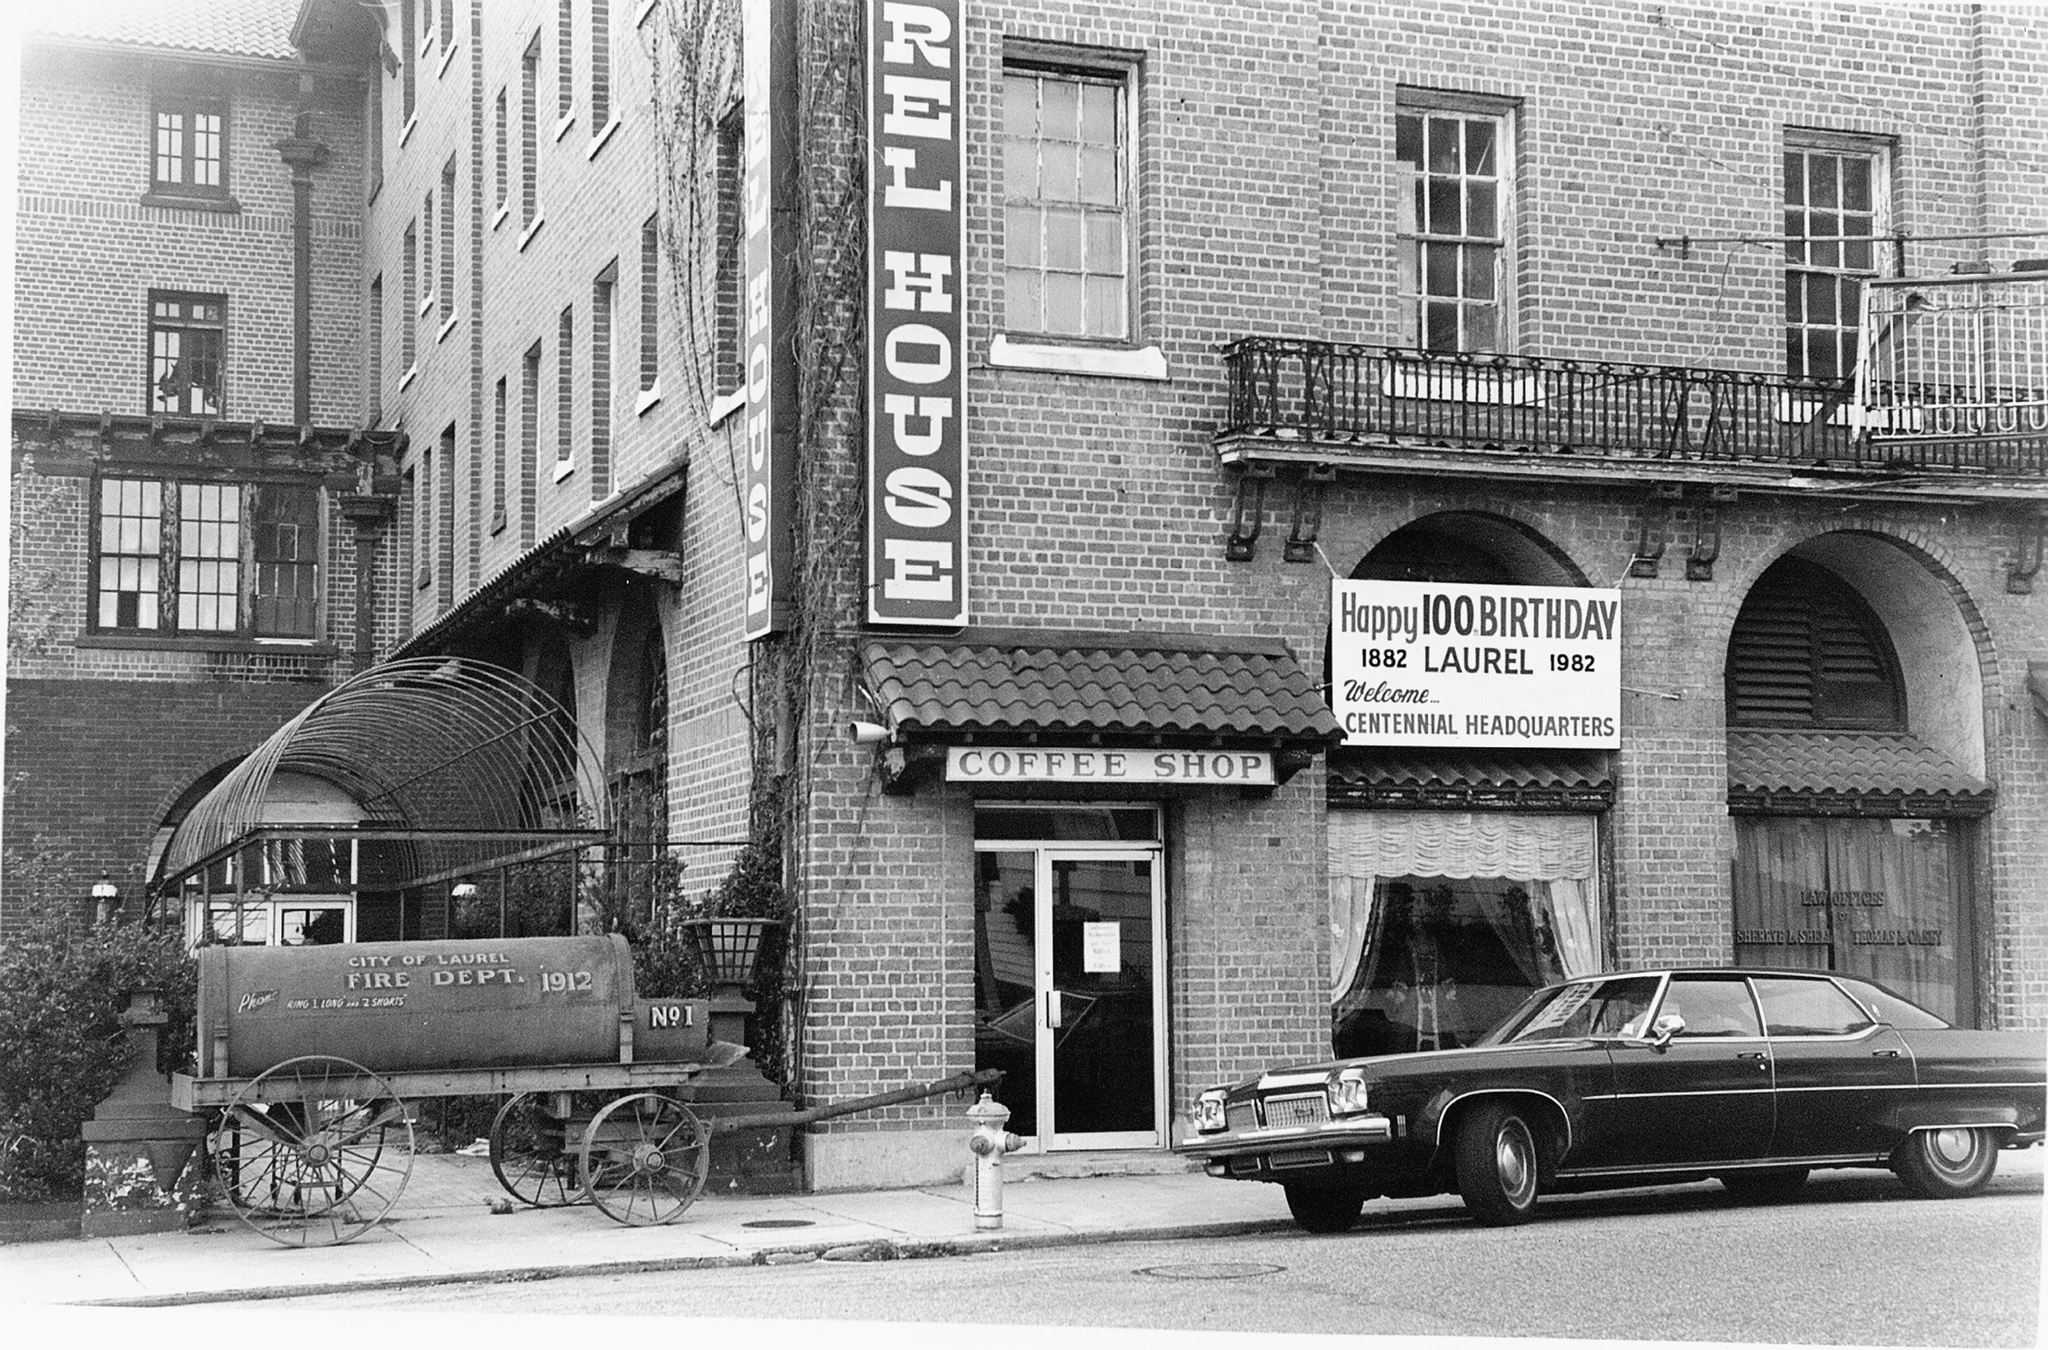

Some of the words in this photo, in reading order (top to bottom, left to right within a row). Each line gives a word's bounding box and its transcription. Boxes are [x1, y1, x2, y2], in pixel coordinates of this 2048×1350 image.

[883, 1, 952, 211] REL
[884, 251, 953, 602] HOUSE
[747, 266, 769, 616] HOUSE
[1341, 592, 1418, 644] Happy
[1423, 594, 1475, 636] 100
[1480, 595, 1618, 641] BIRTHDAY
[1361, 648, 1407, 668] 1882
[1424, 646, 1534, 675] LAUREL
[1550, 654, 1596, 672] 1982
[1343, 679, 1440, 704] Welcome...
[1345, 712, 1458, 735] CENTENNIAL
[1465, 715, 1615, 738] HEADQUARTERS
[958, 751, 1127, 777] COFFEE
[1153, 753, 1262, 779] SHOP
[348, 956, 391, 967] CITY
[402, 955, 426, 966] OF
[438, 953, 510, 965] LAUREL
[347, 971, 410, 989] FIRE
[434, 969, 525, 986] DEPT.
[541, 971, 593, 992] 1912
[287, 999, 309, 1008] RING
[362, 998, 369, 1007] 2
